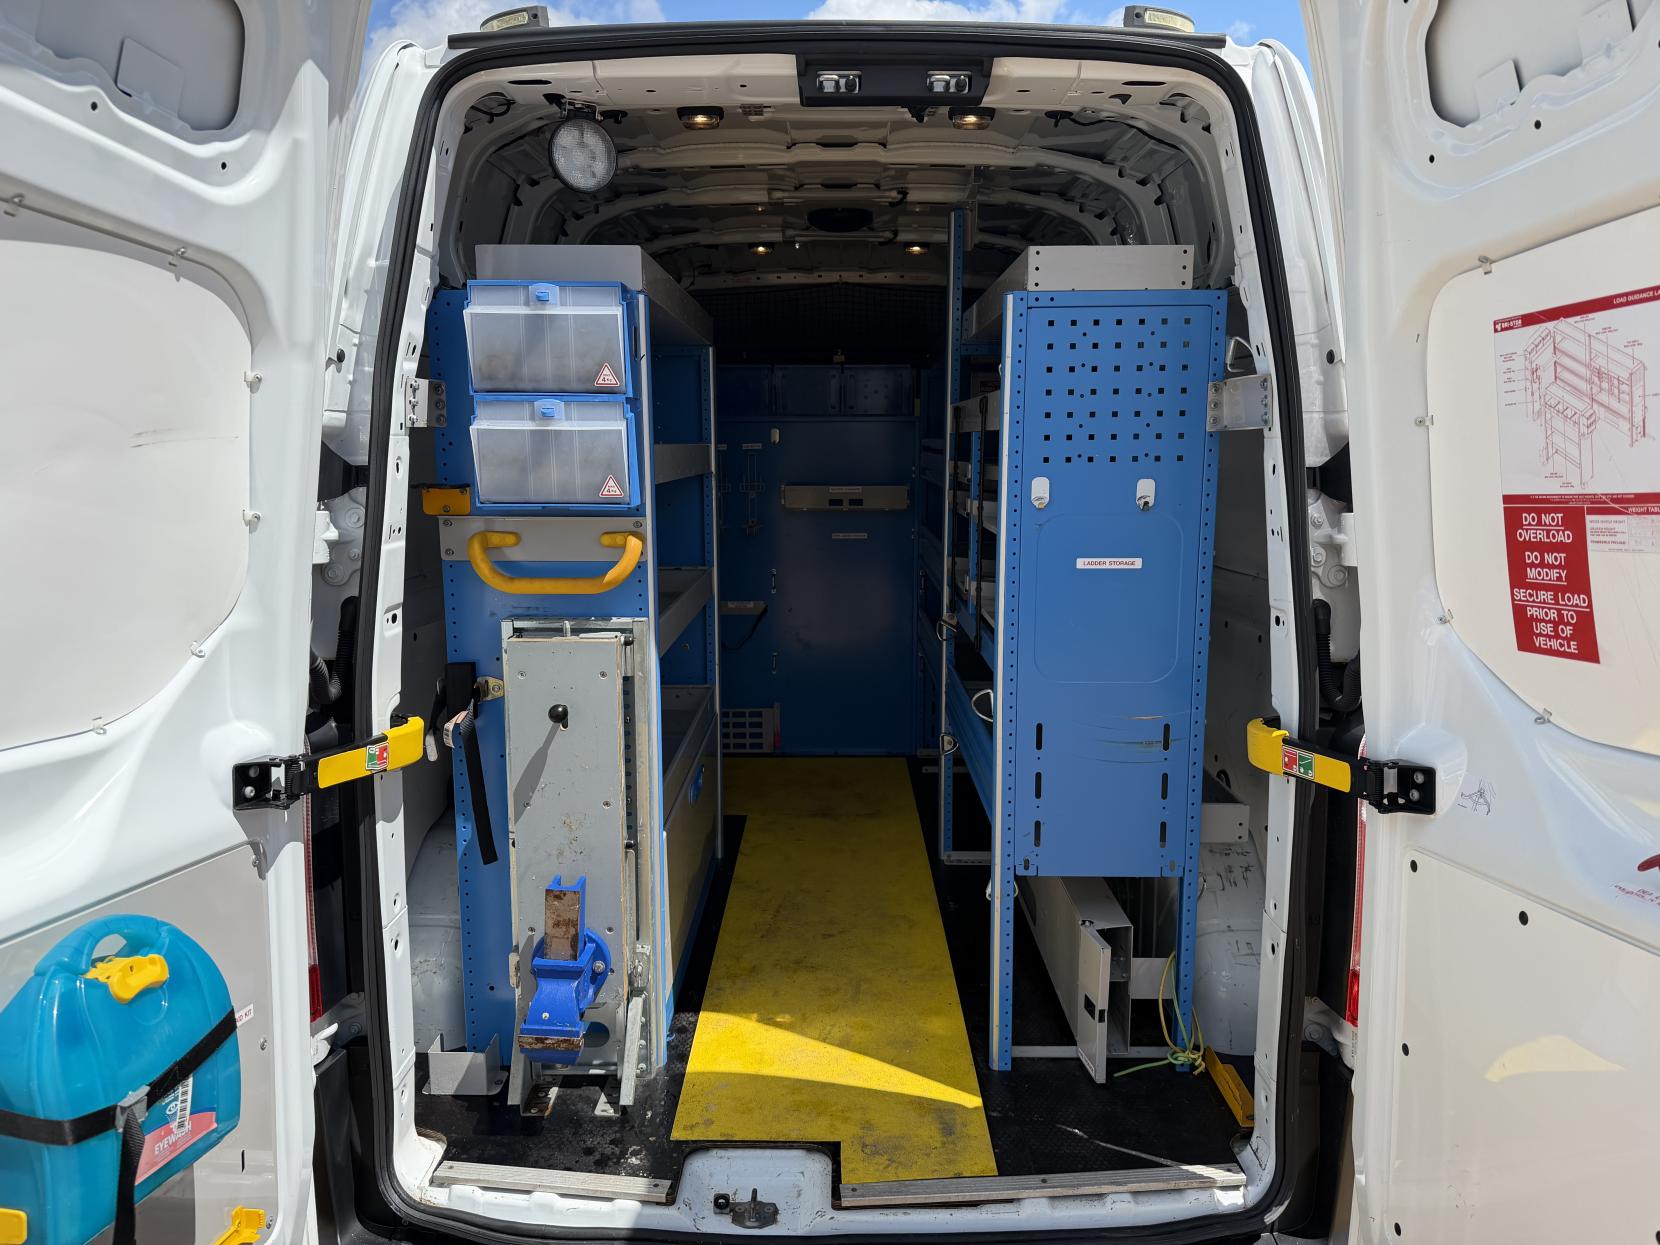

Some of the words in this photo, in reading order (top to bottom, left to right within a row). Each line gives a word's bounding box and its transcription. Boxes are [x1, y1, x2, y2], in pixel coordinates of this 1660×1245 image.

[1522, 513, 1538, 525] DO
[1541, 513, 1563, 526] NOT
[1516, 529, 1573, 543] OVERLOAD
[1525, 551, 1540, 564] DO
[1544, 552, 1566, 566] NOT
[1526, 567, 1567, 581] MODIFY
[1513, 588, 1555, 604] SECURE
[1558, 592, 1589, 607] LOAD
[1526, 606, 1558, 621] PRIOR
[1562, 610, 1577, 624] TO
[1532, 622, 1554, 635] USE
[1558, 624, 1574, 638] OF
[1533, 636, 1579, 653] VEHICLE
